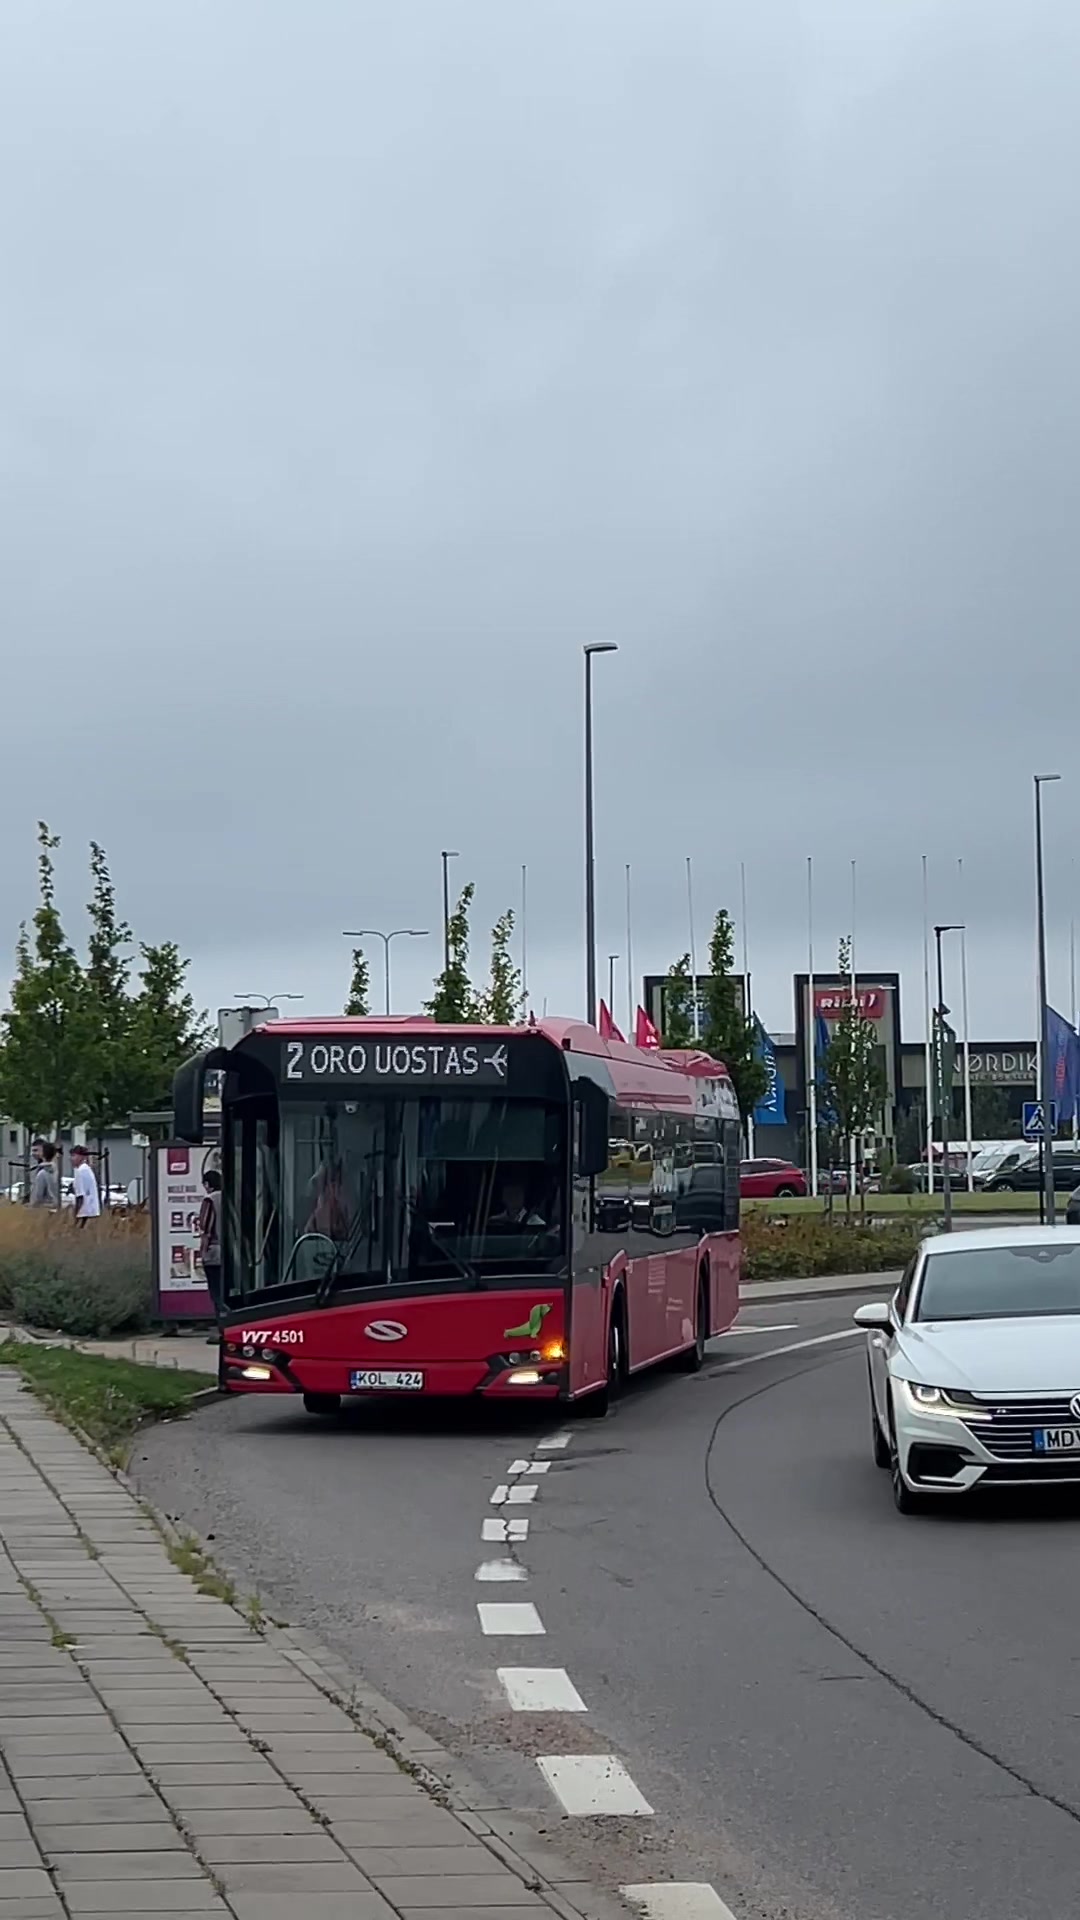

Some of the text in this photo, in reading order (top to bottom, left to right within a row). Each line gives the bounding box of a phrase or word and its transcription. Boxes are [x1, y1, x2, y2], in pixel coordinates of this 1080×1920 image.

[287, 1042, 479, 1078] 2 ORO UOSTAS
[242, 1330, 304, 1343] VVT 4501
[358, 1372, 421, 1386] KOL 424
